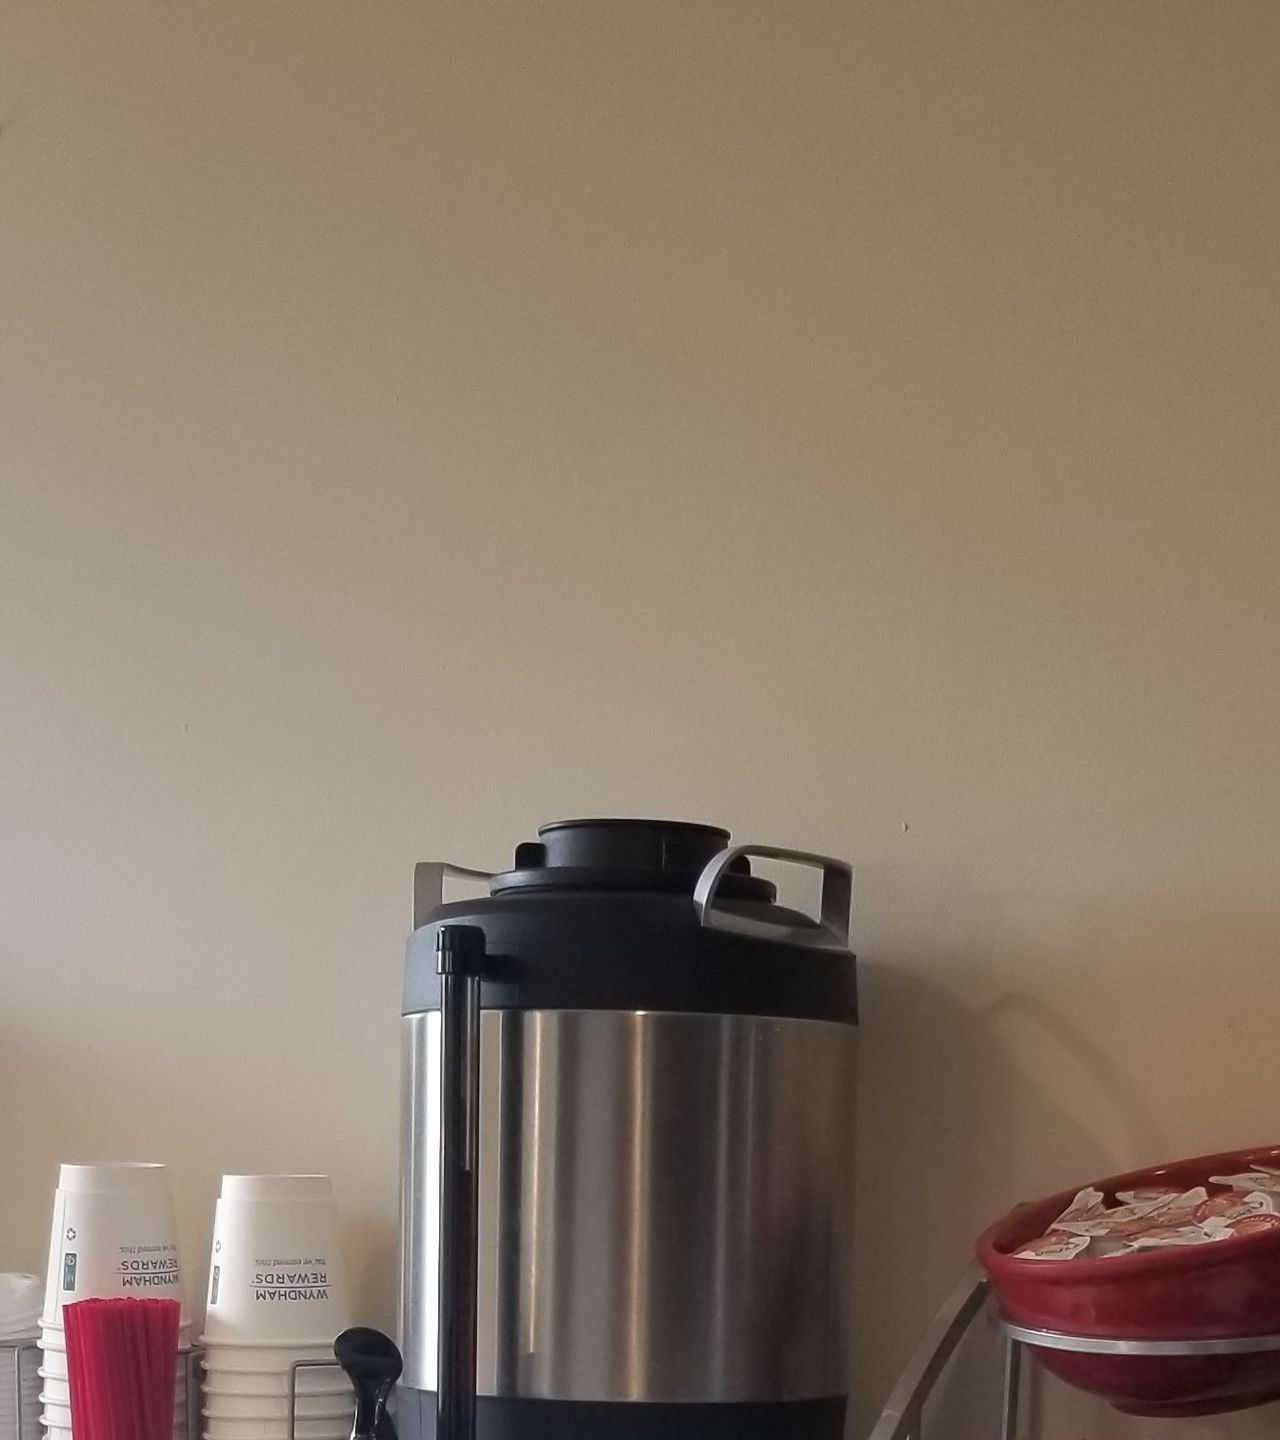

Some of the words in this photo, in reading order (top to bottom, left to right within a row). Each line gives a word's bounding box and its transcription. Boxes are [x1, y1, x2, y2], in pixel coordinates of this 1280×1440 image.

[121, 1258, 178, 1271] REWARDS
[122, 1273, 178, 1287] WYNDHAM
[254, 1272, 327, 1285] REWARDS
[256, 1289, 328, 1301] WYNDHAM
